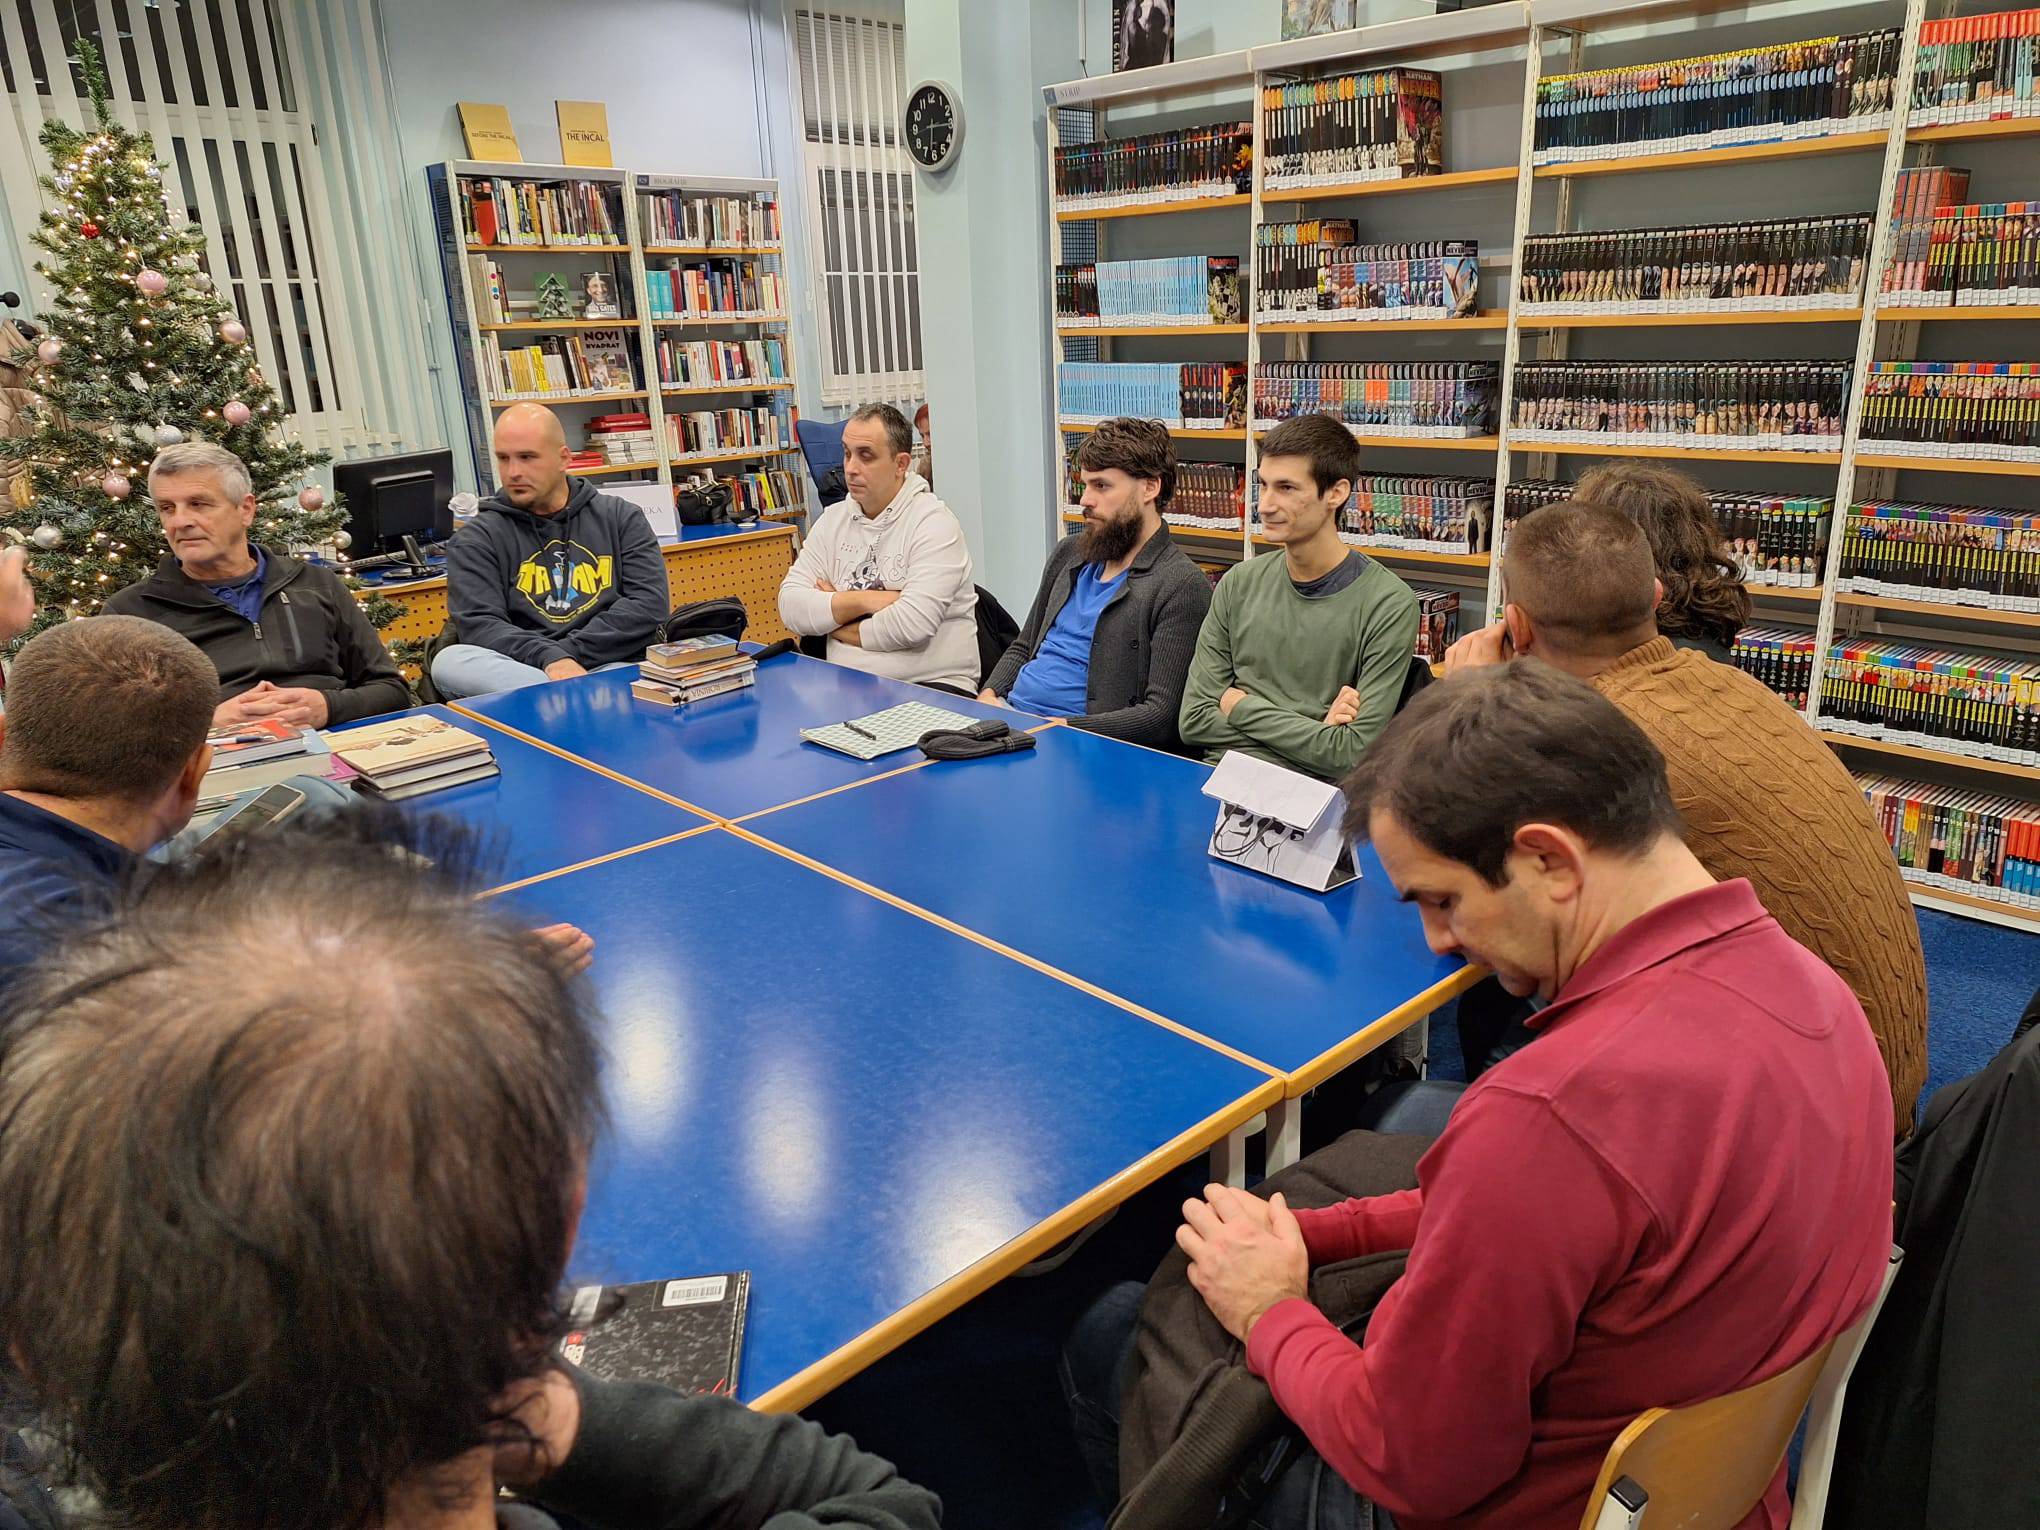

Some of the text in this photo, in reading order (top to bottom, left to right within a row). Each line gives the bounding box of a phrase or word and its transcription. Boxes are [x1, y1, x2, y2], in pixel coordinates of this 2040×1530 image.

[1405, 71, 1433, 80] NATHAN
[1400, 79, 1440, 97] NEVER
[927, 91, 936, 103] 12
[939, 95, 943, 106] 1
[919, 98, 926, 111] 11
[944, 104, 951, 116] 2
[912, 109, 922, 122] 10
[912, 123, 919, 135] 9
[947, 118, 954, 129] 3
[566, 132, 580, 141] THE
[581, 133, 605, 142] INCAL
[946, 133, 952, 142] 4
[915, 138, 922, 149] 8
[922, 146, 929, 158] 7
[940, 144, 946, 155] 5
[931, 150, 938, 161] 6
[583, 331, 619, 341] NOVI
